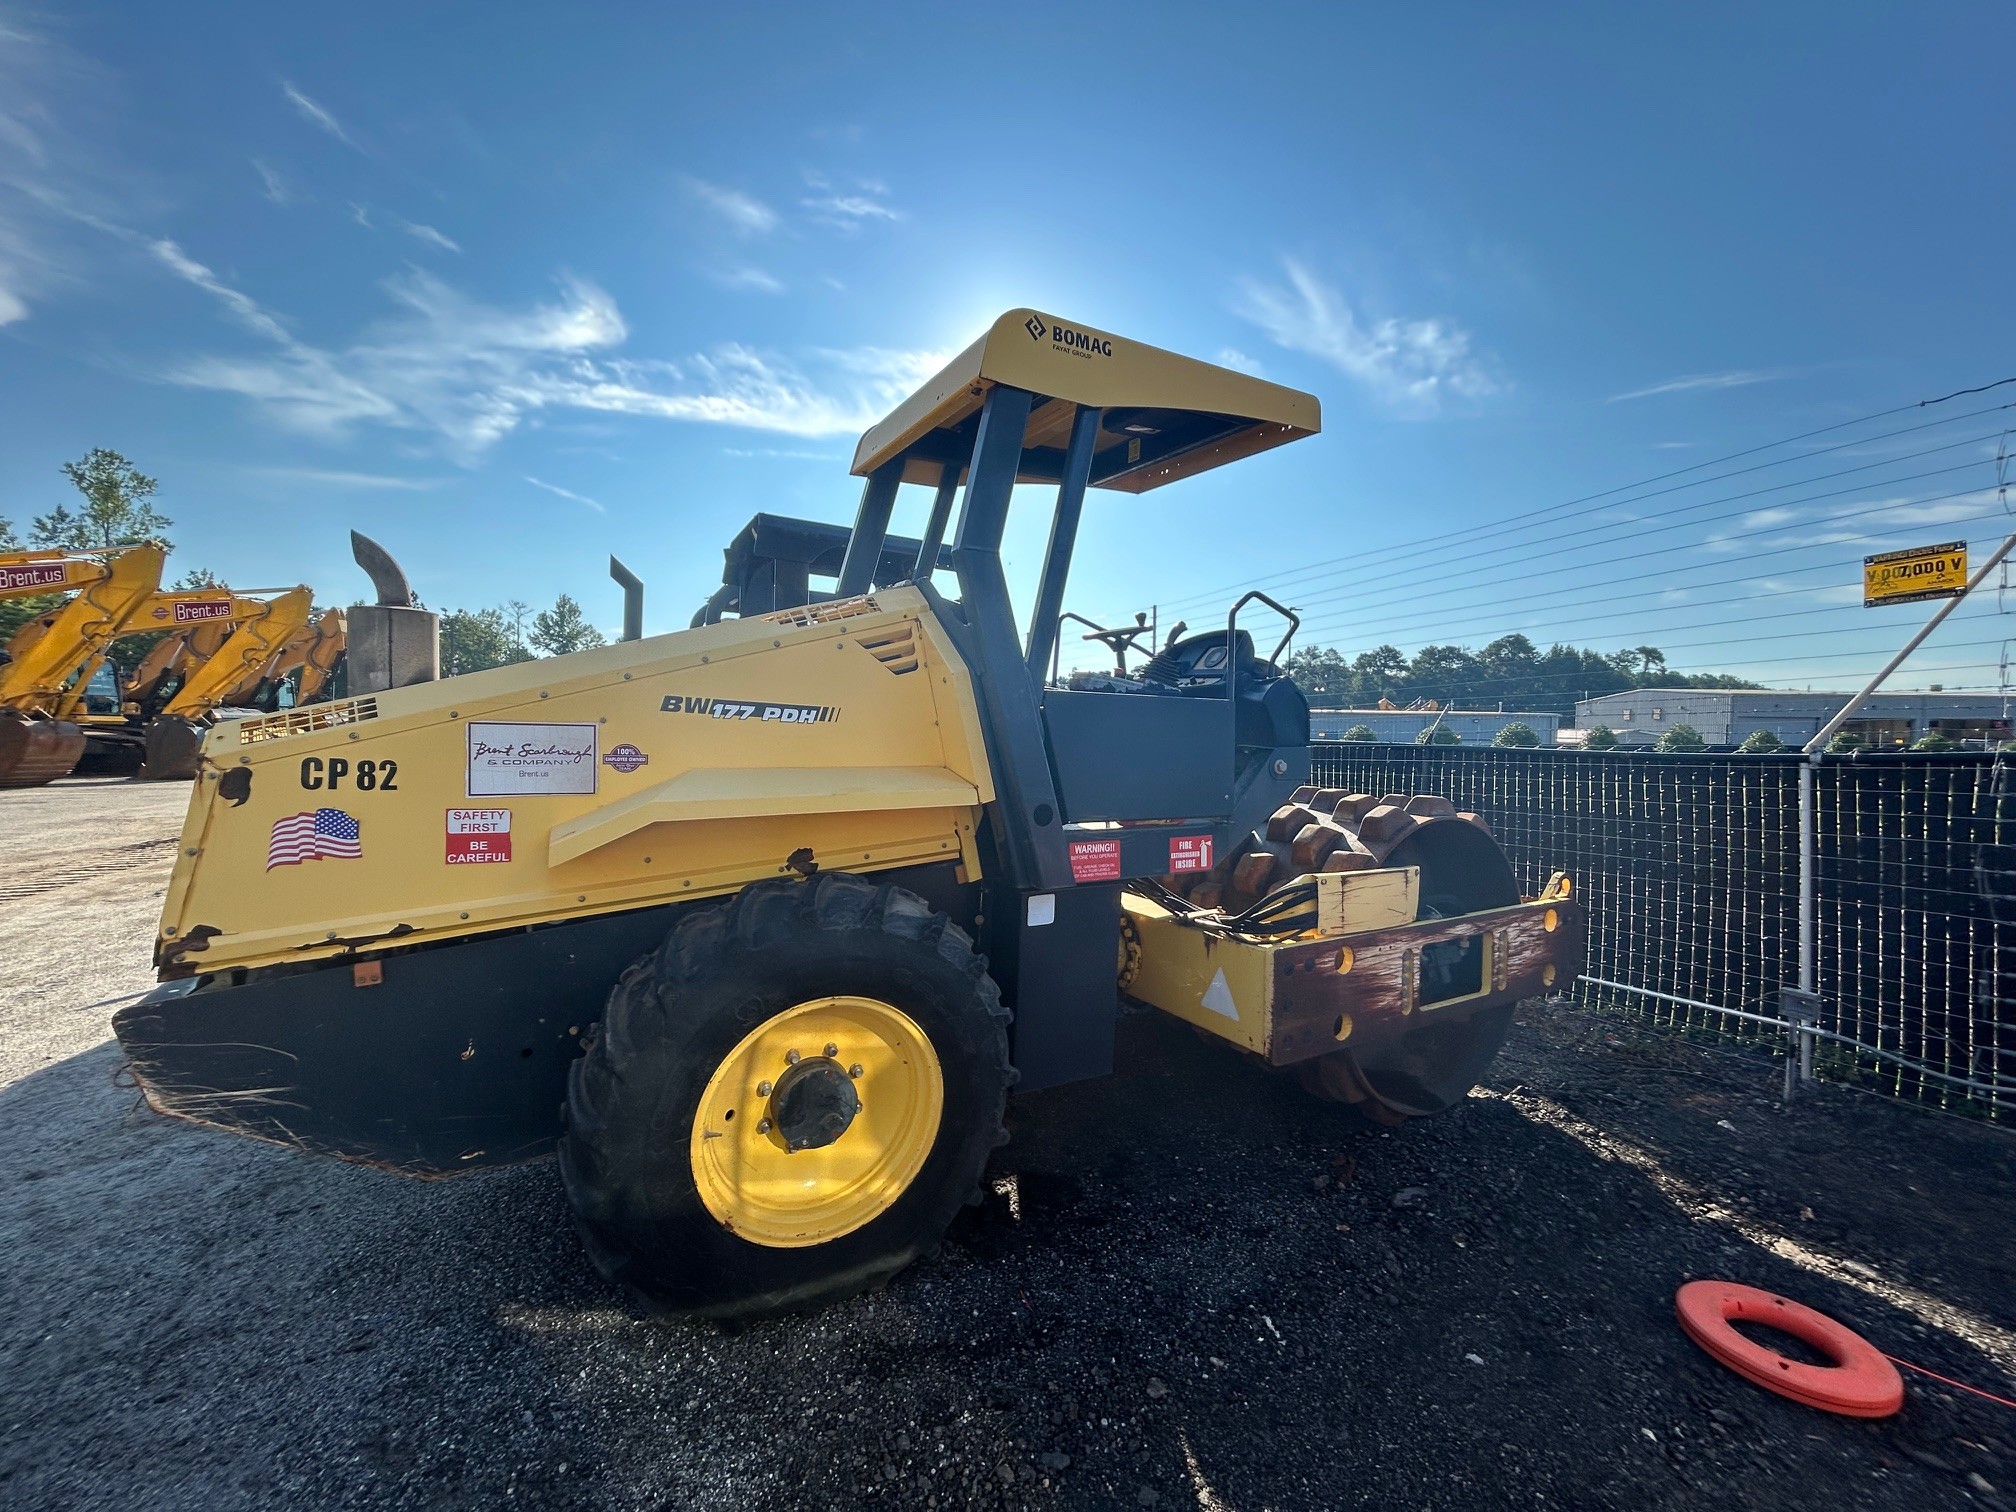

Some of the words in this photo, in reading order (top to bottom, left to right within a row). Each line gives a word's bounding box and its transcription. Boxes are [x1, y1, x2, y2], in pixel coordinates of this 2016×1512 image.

[1053, 326, 1111, 357] BOMAG
[1052, 344, 1070, 354] FAYAT
[1072, 349, 1092, 359] GROUP
[1900, 560, 1945, 578] 7,000
[1951, 557, 1962, 570] V
[0, 569, 62, 588] Brent.us
[176, 604, 229, 620] Brent.us
[761, 707, 817, 724] PDH
[473, 741, 514, 760] Brent
[300, 757, 348, 790] CP
[356, 760, 398, 791] 82
[518, 769, 549, 778] Brent.us
[453, 811, 505, 820] SAFETY
[460, 823, 498, 832] FIRST
[469, 841, 488, 851] BE
[1074, 843, 1115, 854] WARNING!!
[447, 852, 510, 864] CAREFUL
[1175, 859, 1196, 869] INSIDE
